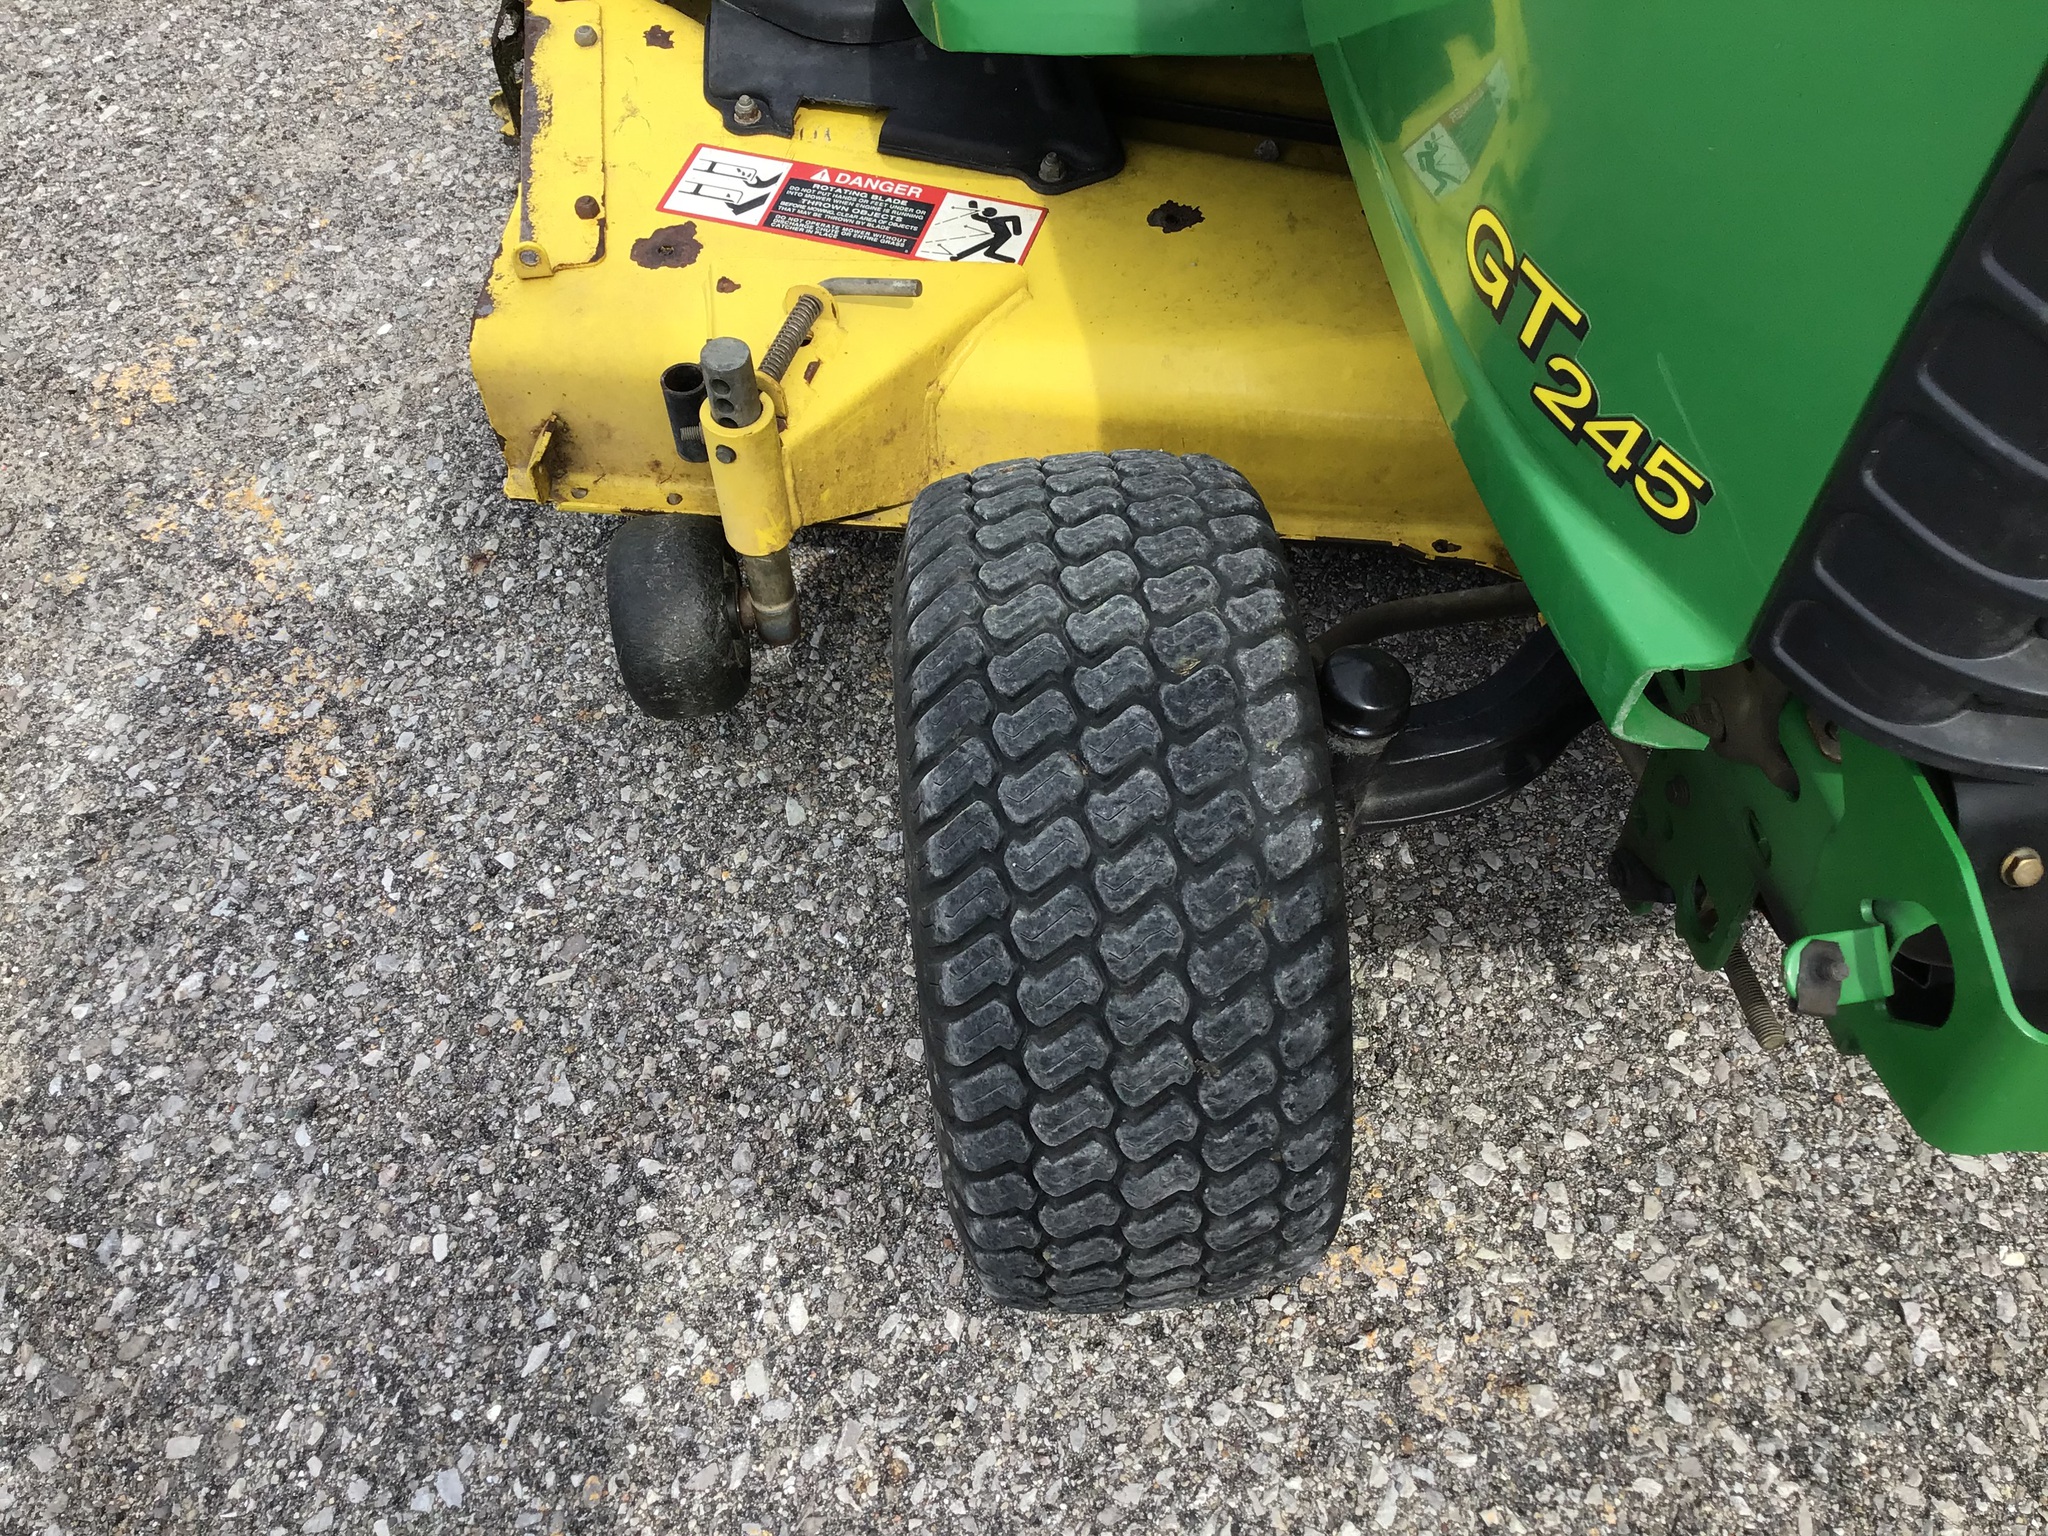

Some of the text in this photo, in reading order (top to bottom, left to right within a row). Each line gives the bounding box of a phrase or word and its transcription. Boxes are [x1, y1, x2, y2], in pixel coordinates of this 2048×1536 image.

[812, 183, 908, 206] ROTATING BLADE
[835, 172, 923, 199] DANGER
[801, 198, 903, 222] THROWN OBJECTS
[804, 194, 832, 202] MOWER
[832, 198, 854, 206] WHEN
[855, 202, 881, 212] ENGINE
[891, 210, 924, 220] RUNNING
[832, 192, 857, 202] HANDS
[870, 199, 889, 208] FEET
[889, 203, 914, 213] UNDER
[780, 201, 806, 209] BEFORE
[836, 211, 858, 220] CLEAR
[859, 216, 877, 224] AREA
[888, 221, 918, 231] OBJECTS
[824, 214, 854, 224] THROWN
[866, 222, 890, 231] BLADE
[770, 222, 804, 232] CATCHER
[814, 229, 838, 239] PLACE
[772, 218, 814, 230] DISCHARGE
[815, 226, 840, 235] CHUTE
[852, 233, 879, 242] ENTIRE
[879, 238, 905, 248] GRASS
[805, 220, 840, 230] OPERATE
[841, 227, 871, 236] MOWER
[872, 231, 908, 243] WITHOUT
[1466, 206, 1711, 528] GT 245
